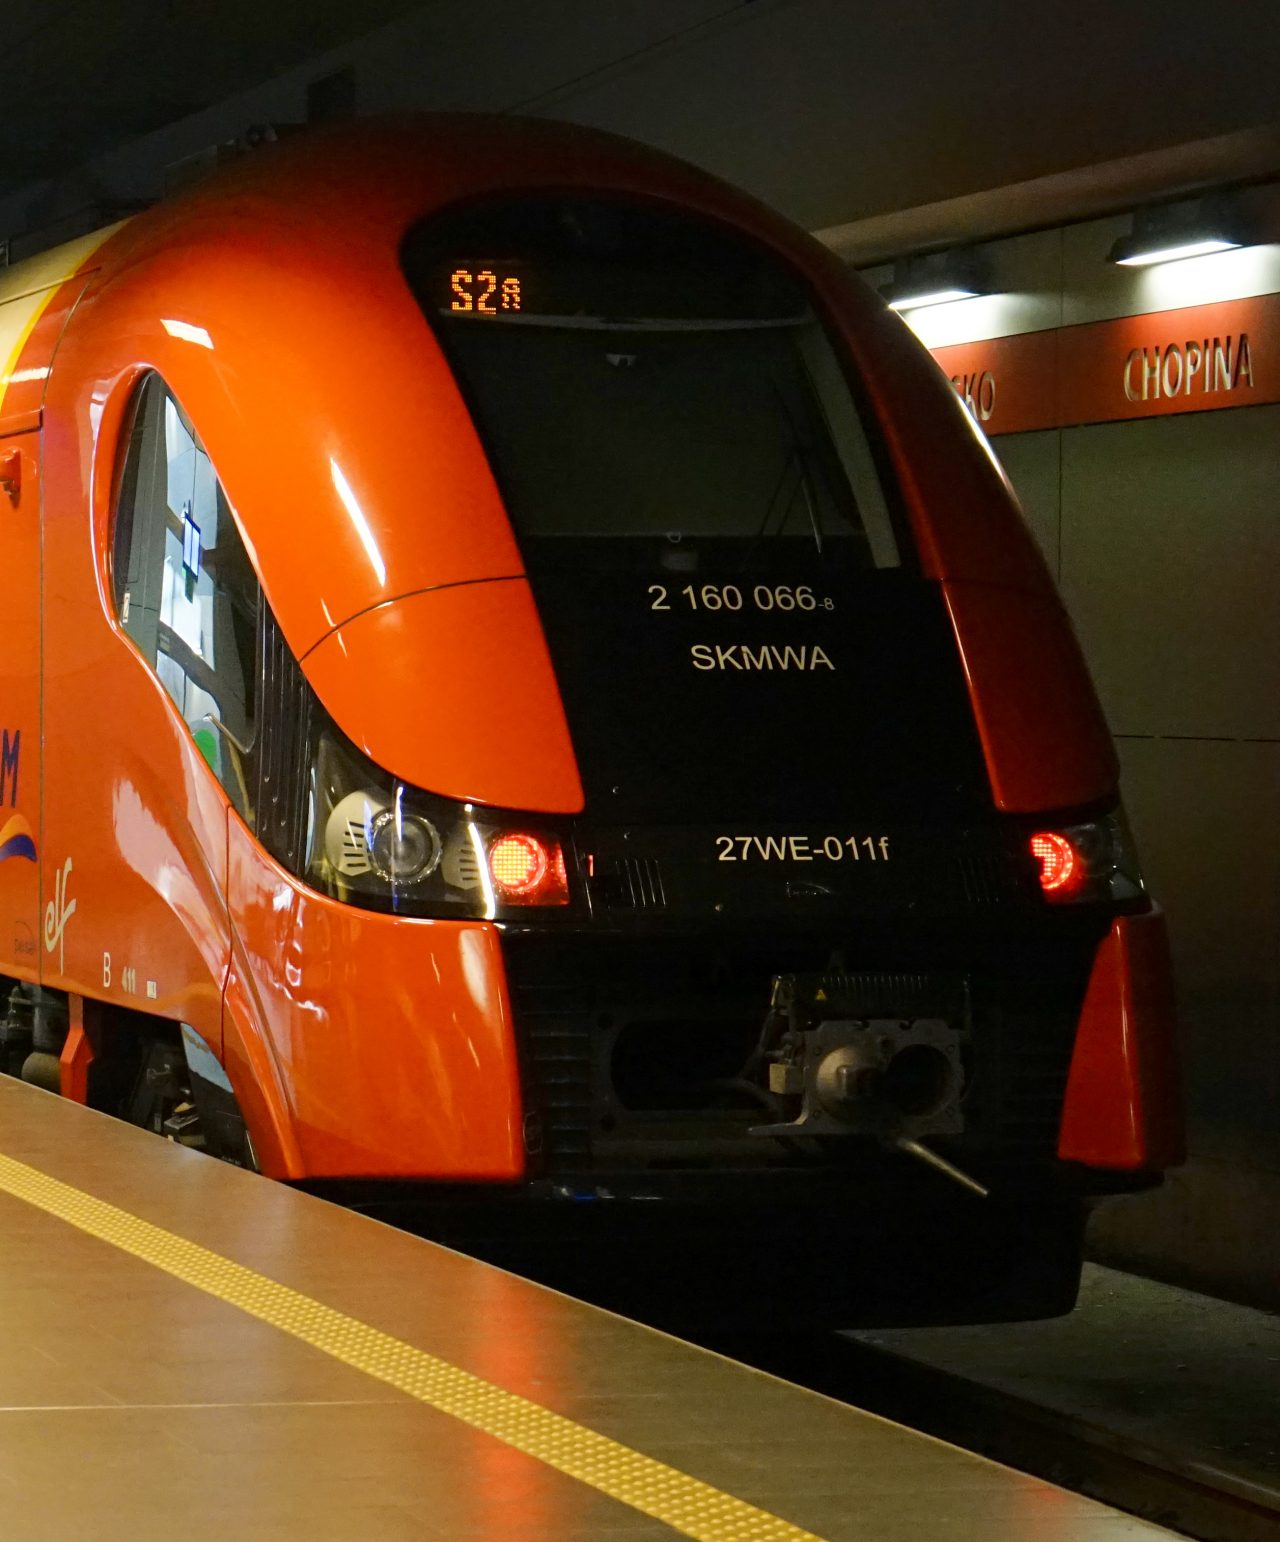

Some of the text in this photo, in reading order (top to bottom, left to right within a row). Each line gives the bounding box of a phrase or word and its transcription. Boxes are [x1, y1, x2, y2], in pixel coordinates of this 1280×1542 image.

[1124, 333, 1253, 401] CHOPINA
[648, 585, 670, 610] 2
[682, 585, 743, 611] 160
[690, 645, 836, 671] SKMWA
[715, 836, 890, 861] 27WE-011f
[103, 951, 111, 988] B
